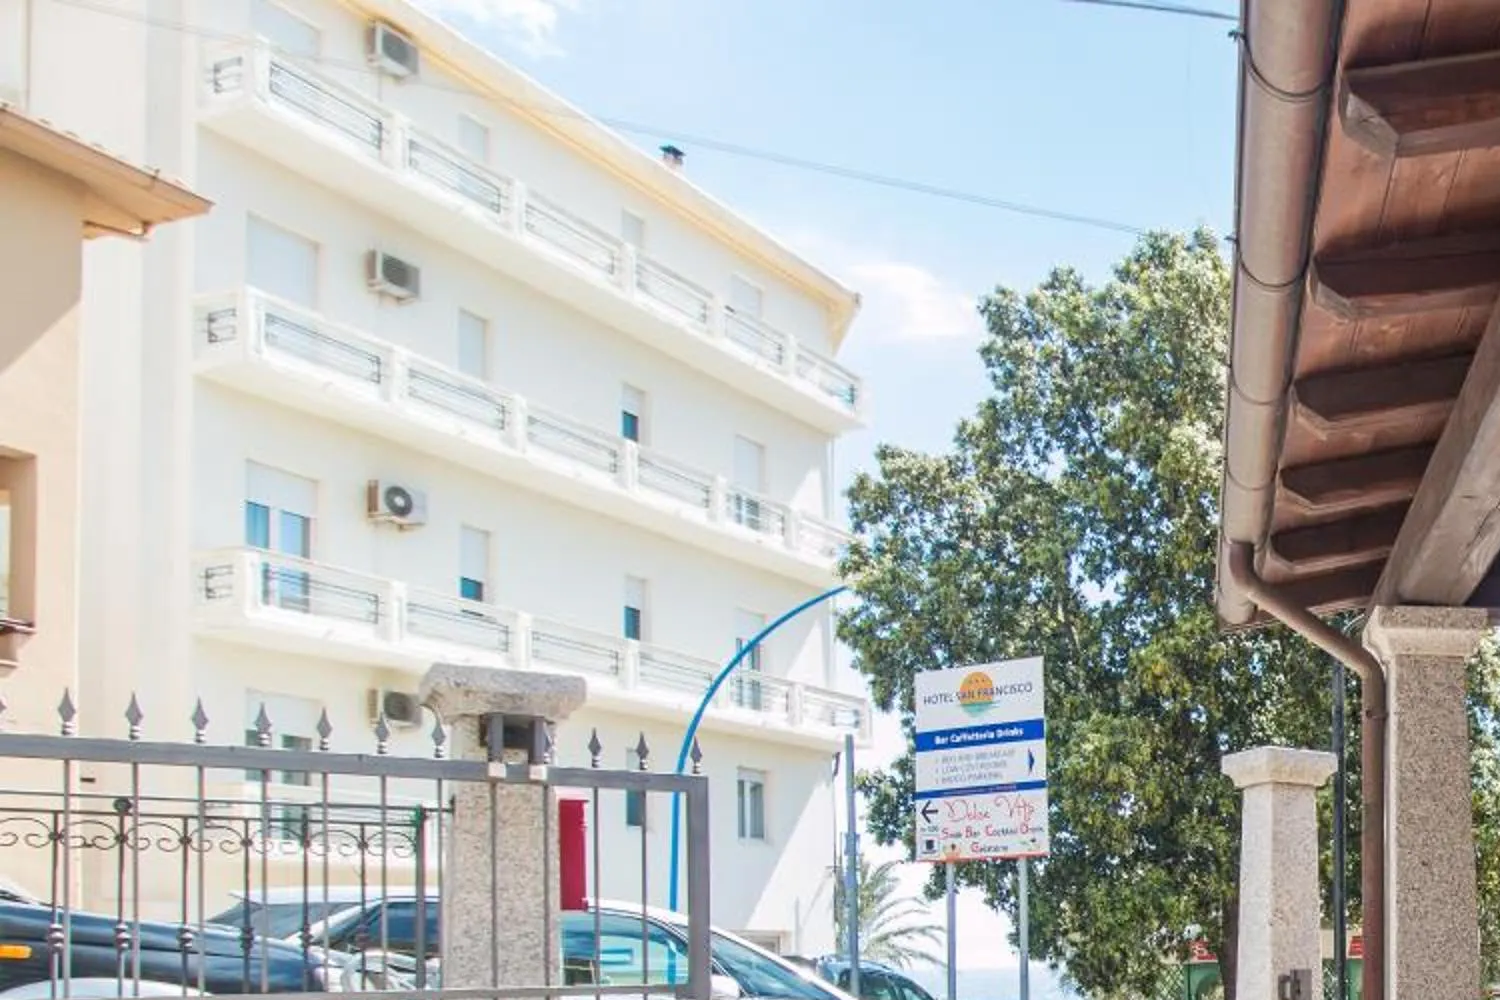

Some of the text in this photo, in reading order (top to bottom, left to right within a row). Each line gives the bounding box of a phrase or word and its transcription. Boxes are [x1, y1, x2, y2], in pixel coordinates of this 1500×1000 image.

[923, 681, 1033, 705] HOTEL SAN FRANCISCO
[934, 734, 949, 746] Bar
[996, 726, 1024, 739] Drinks
